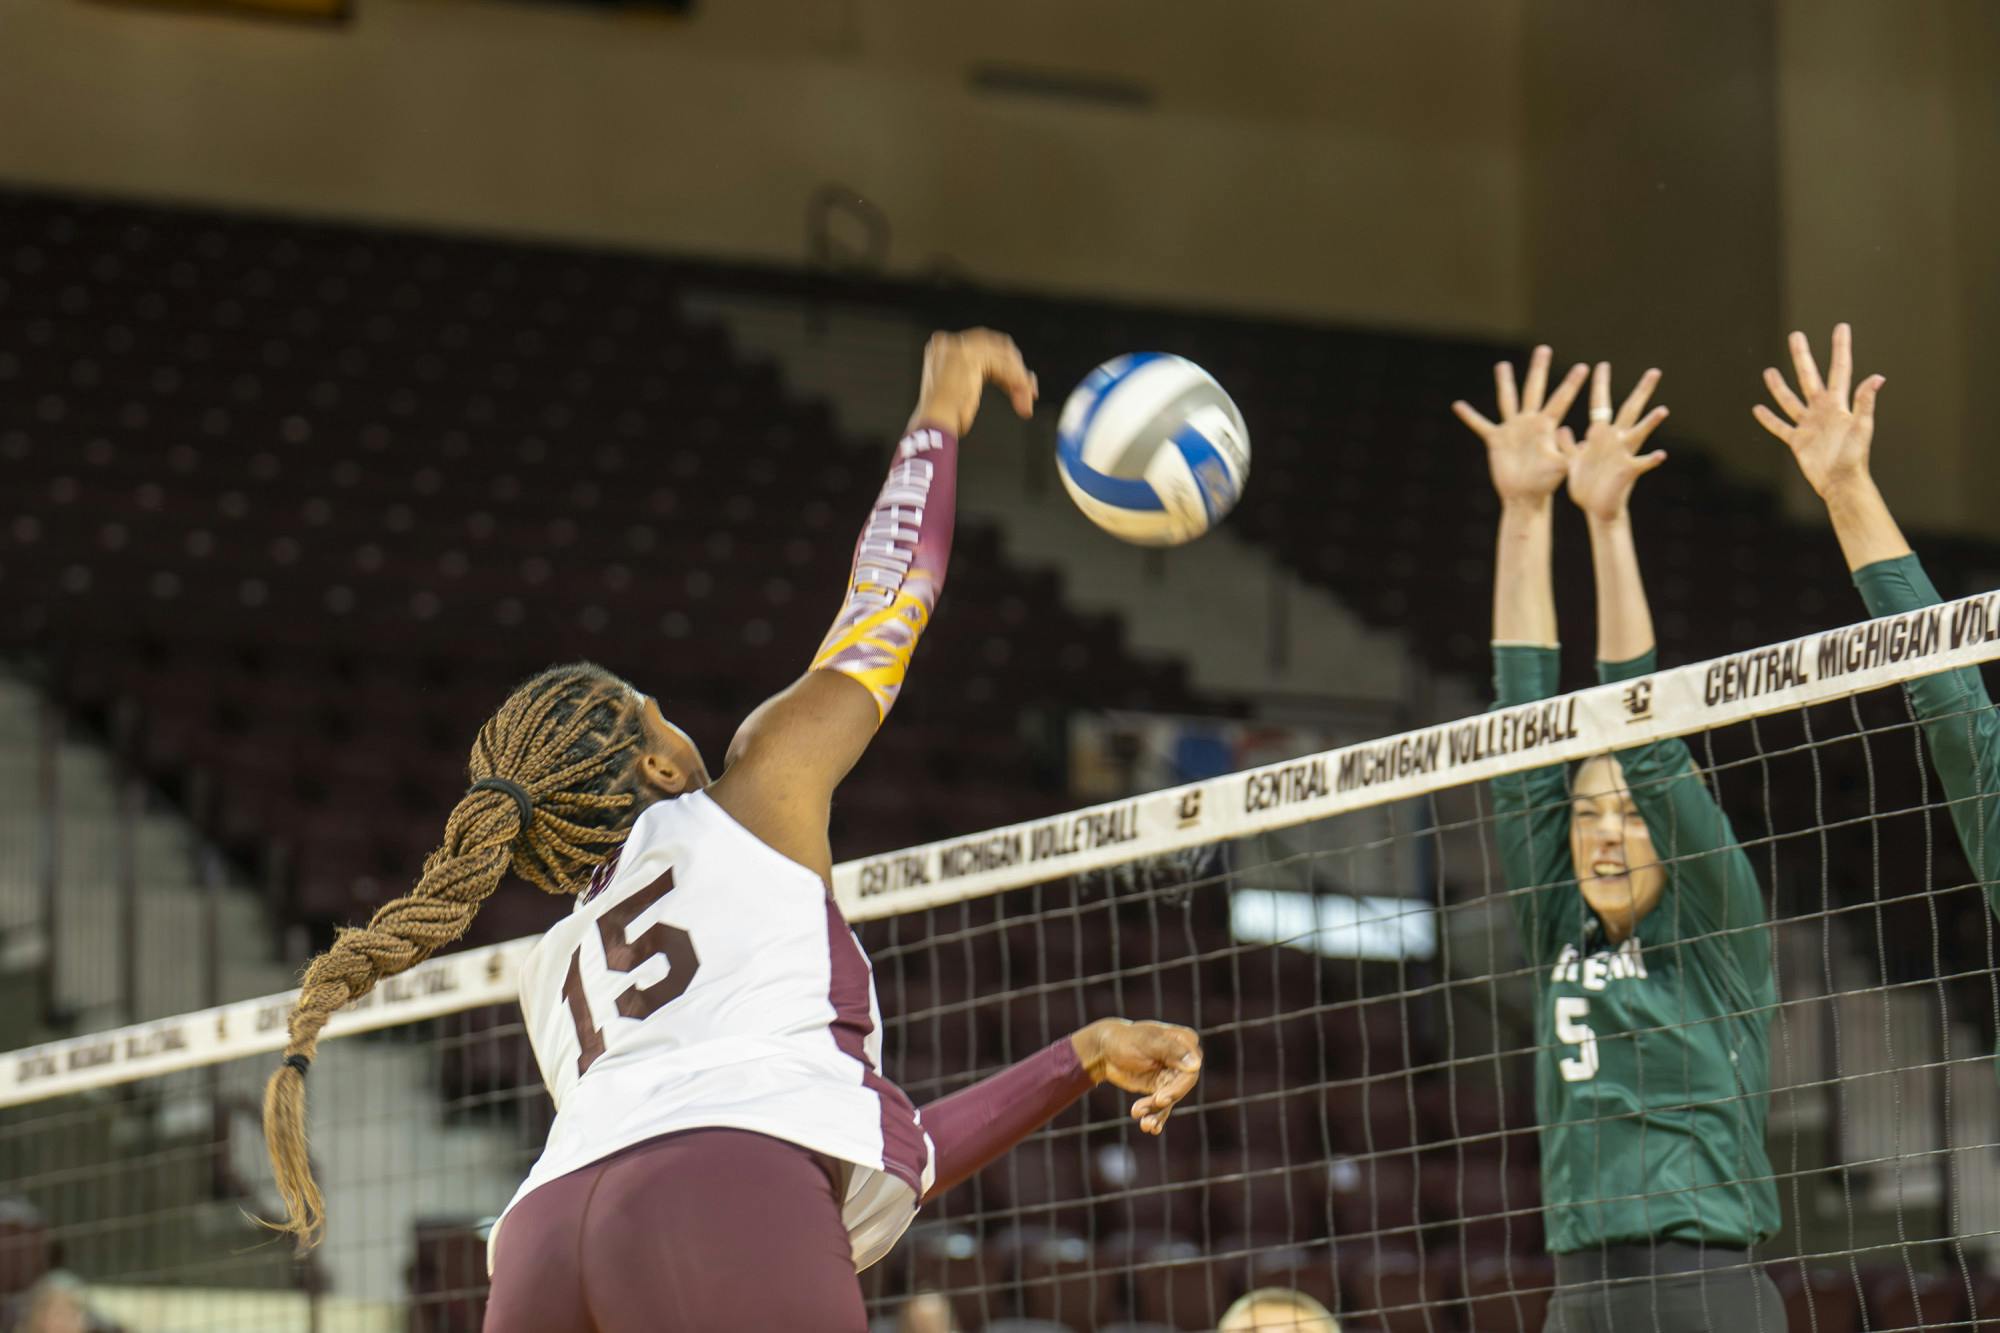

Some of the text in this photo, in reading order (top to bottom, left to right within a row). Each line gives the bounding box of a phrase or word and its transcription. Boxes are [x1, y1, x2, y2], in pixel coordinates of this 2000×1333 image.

[1704, 594, 2000, 706] CENTRAL MICHIGAN VOL
[1245, 696, 1579, 814] CENTRAL MICHIGAN VOLLEYBALL
[1030, 801, 1138, 862] VOLLEYBALL
[561, 865, 700, 1080] 15
[1555, 996, 1599, 1082] 5
